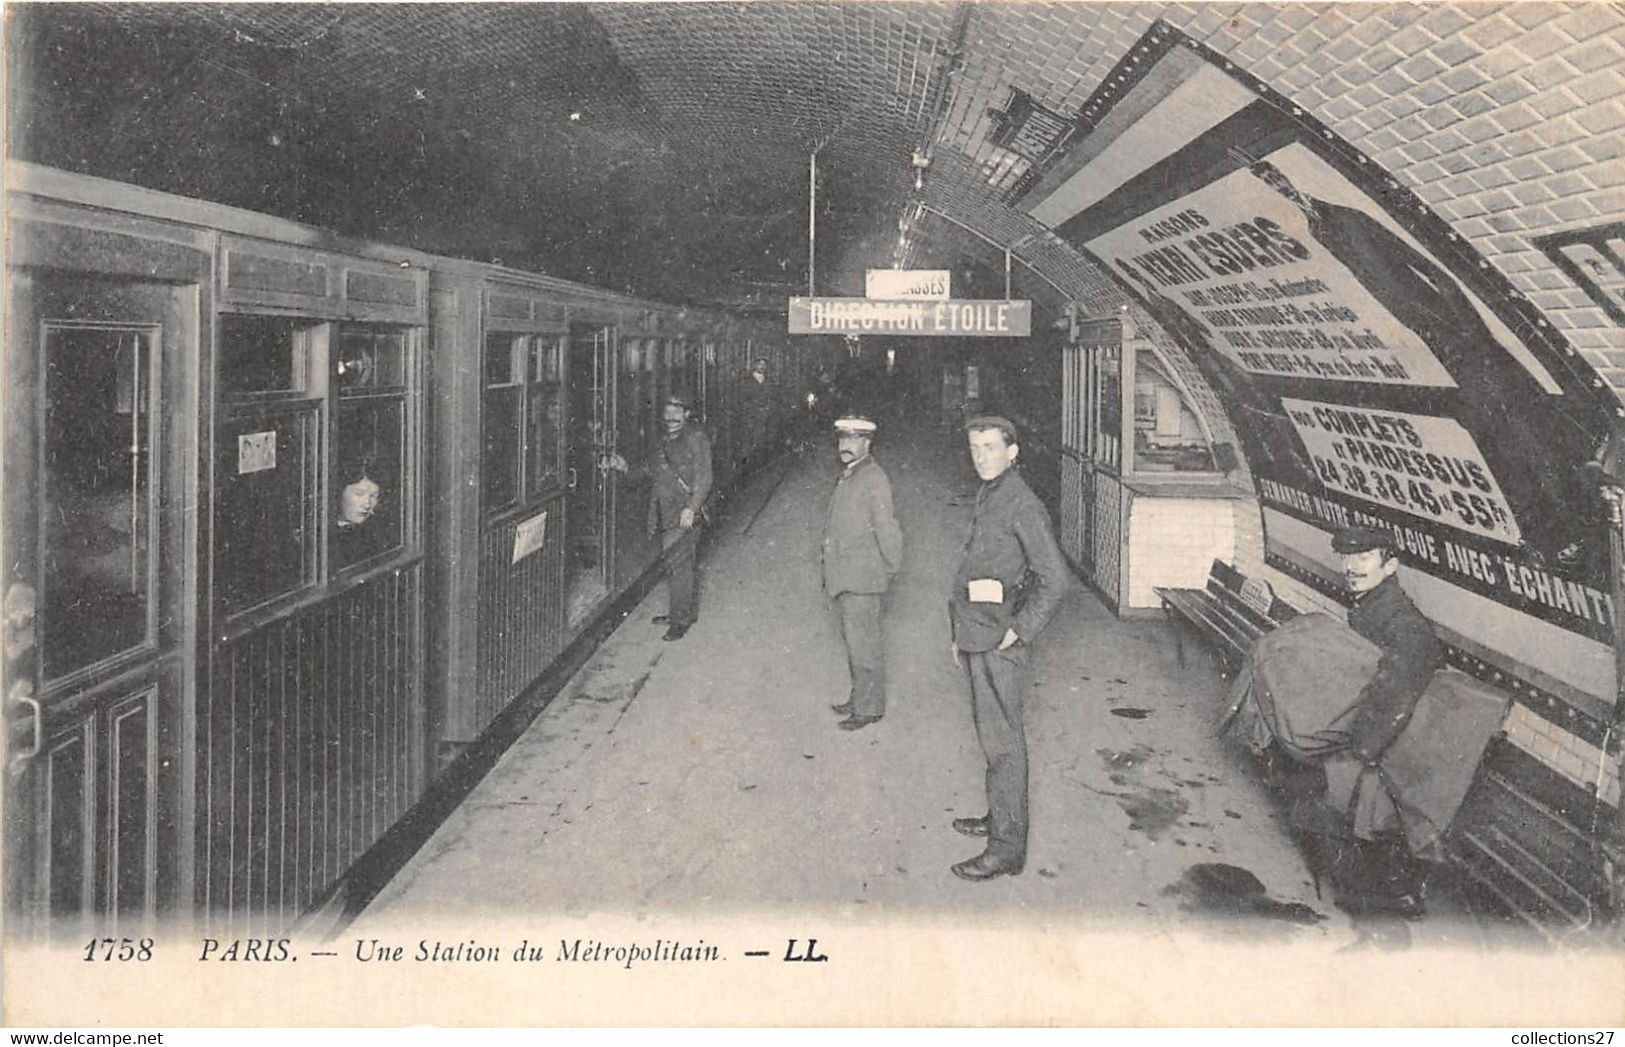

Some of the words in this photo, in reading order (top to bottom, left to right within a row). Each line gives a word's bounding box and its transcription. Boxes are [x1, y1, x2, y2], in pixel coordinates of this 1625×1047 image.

[1138, 209, 1210, 243] MAISONS
[1132, 244, 1210, 287] HENRI
[1184, 216, 1310, 276] ESDERS
[810, 302, 924, 331] DIRECTION
[934, 301, 1009, 332] ÉTOILE
[1312, 406, 1422, 449] COMPLETS
[1343, 437, 1491, 493] PARDESSUS
[1444, 541, 1496, 585] AVEC
